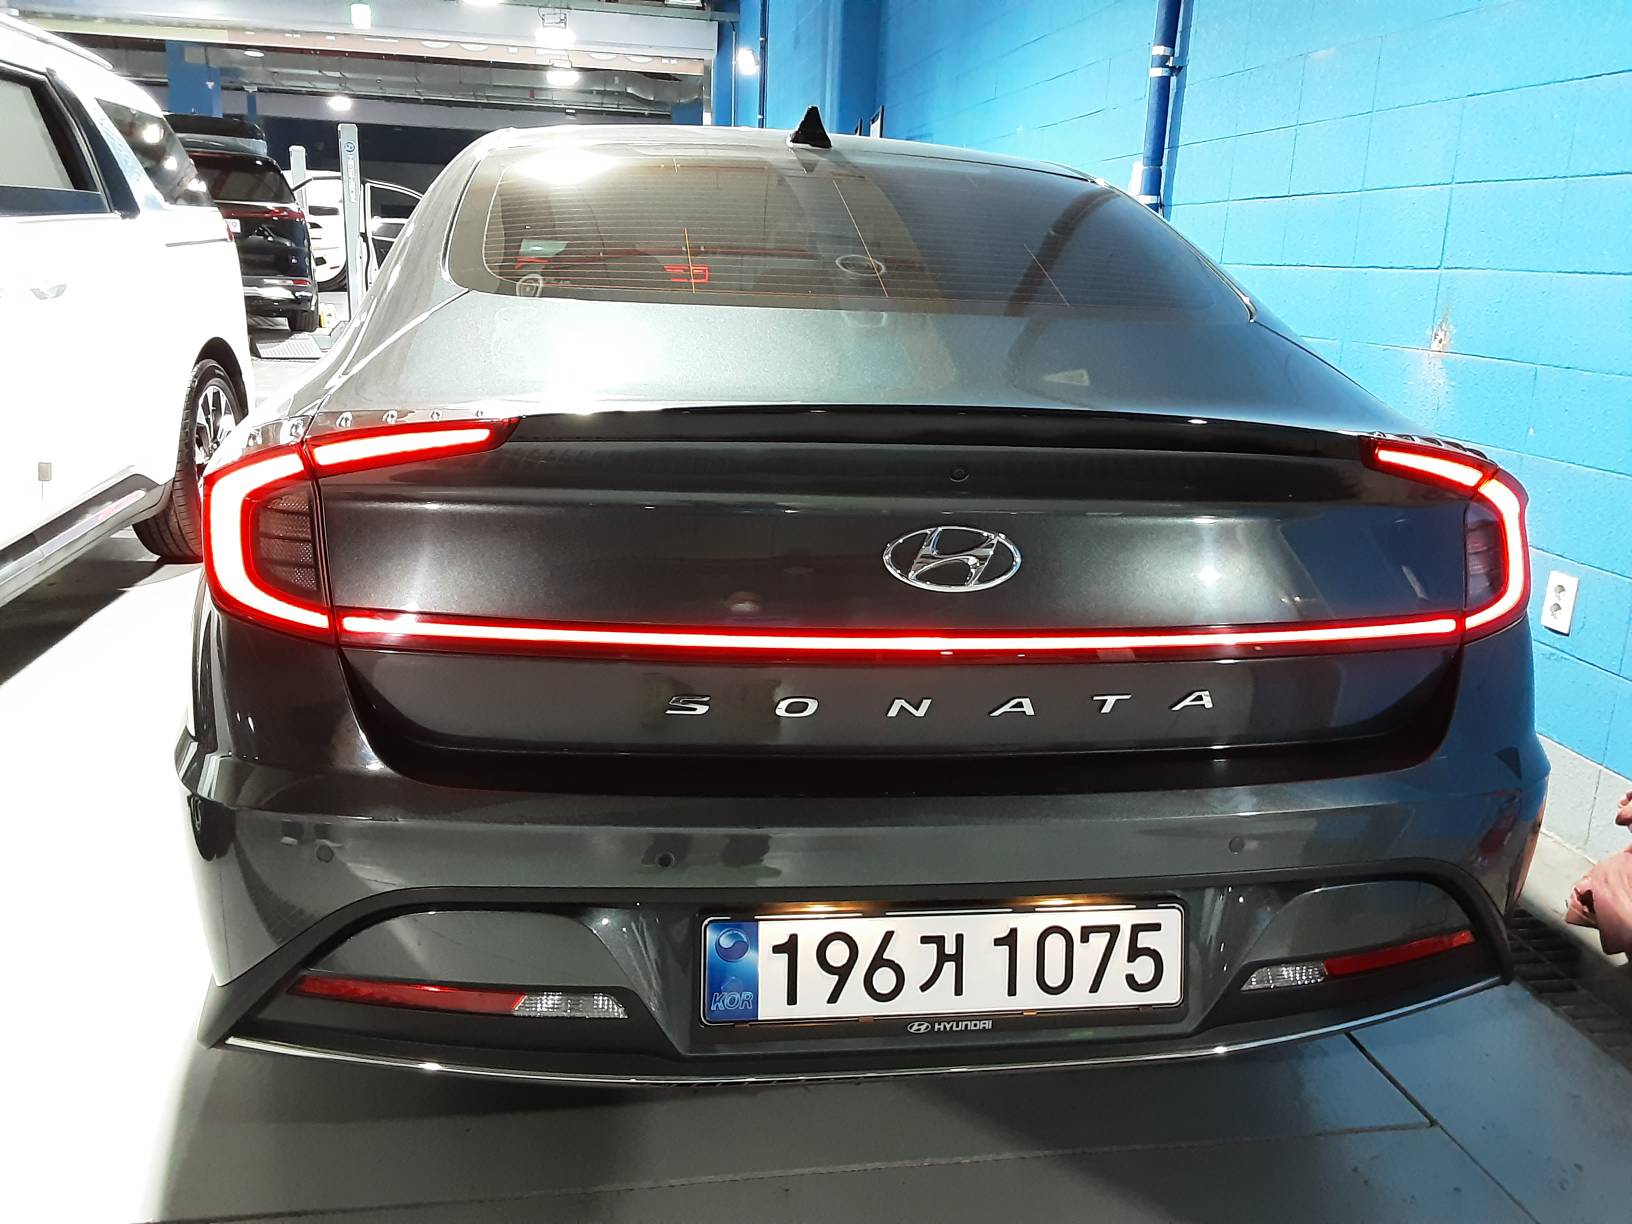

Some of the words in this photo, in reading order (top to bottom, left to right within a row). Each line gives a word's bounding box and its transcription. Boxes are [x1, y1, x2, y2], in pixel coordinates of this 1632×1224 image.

[666, 690, 1214, 718] SONATA
[771, 930, 965, 1006] 196거
[993, 924, 1164, 997] 1075
[711, 991, 754, 1012] KOR
[933, 1019, 993, 1032] HYUNDAI
